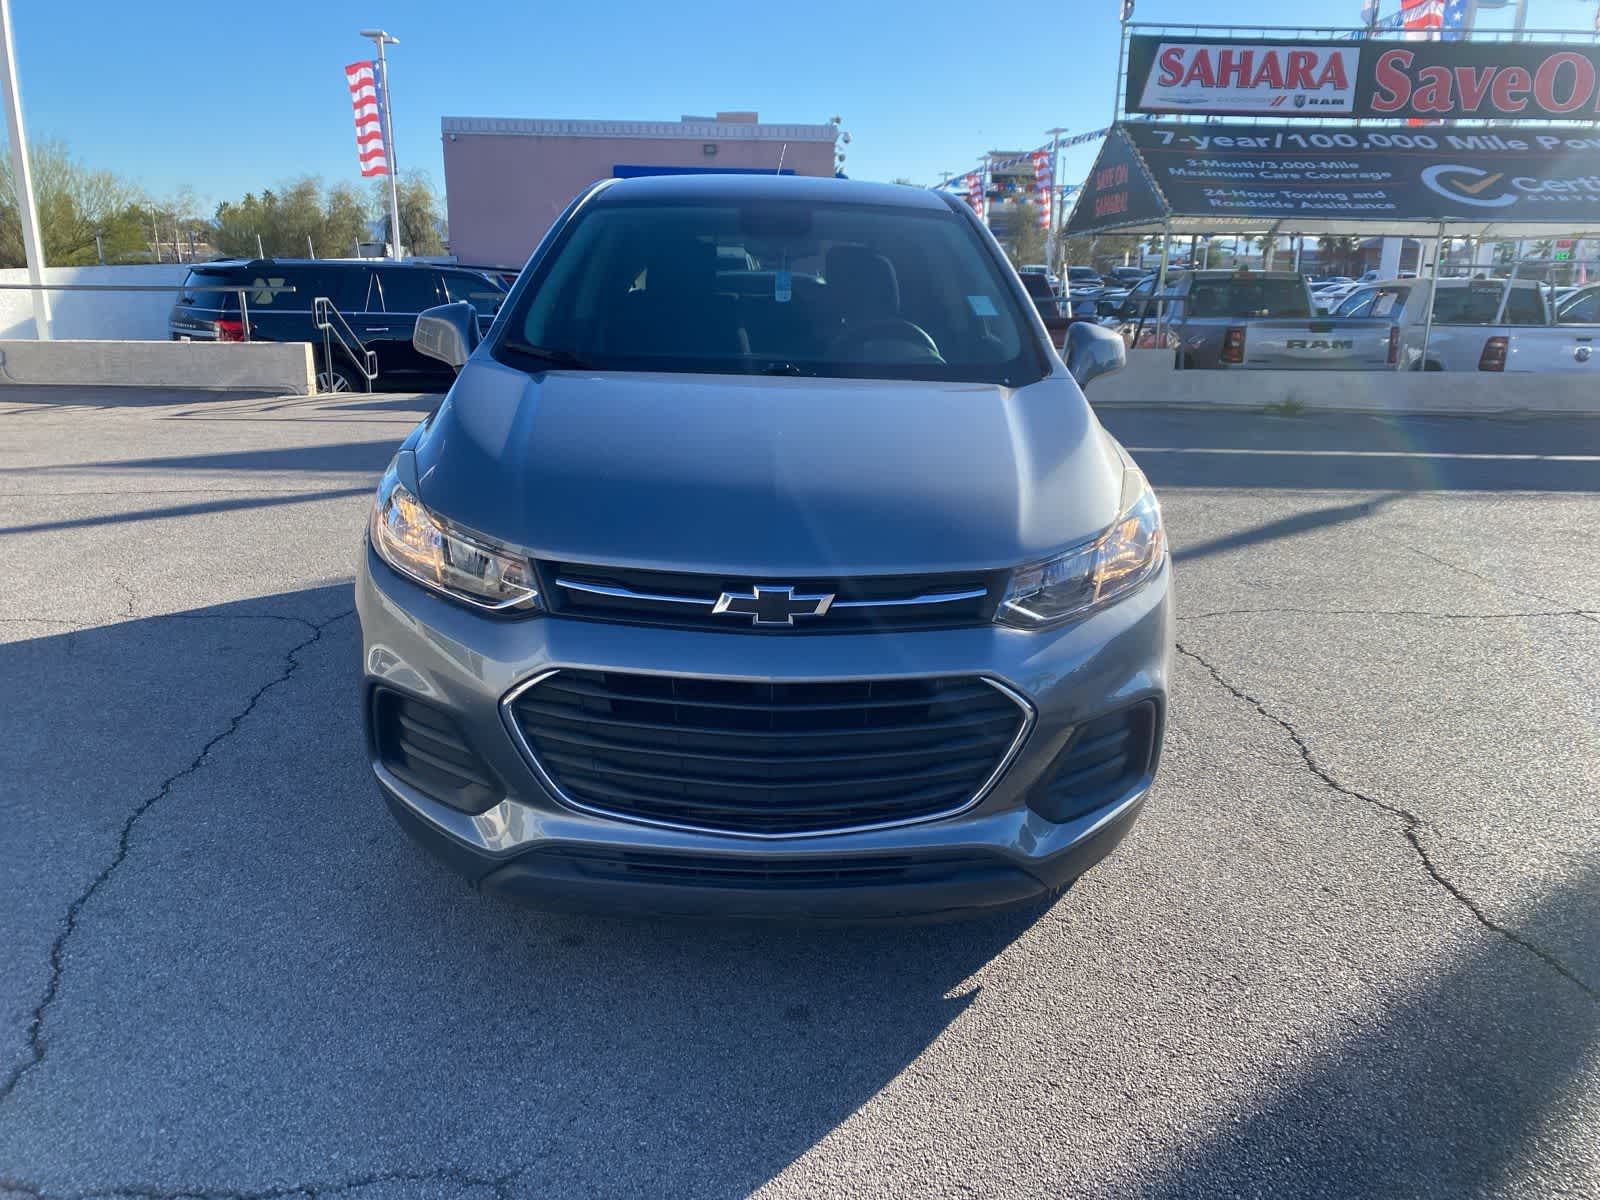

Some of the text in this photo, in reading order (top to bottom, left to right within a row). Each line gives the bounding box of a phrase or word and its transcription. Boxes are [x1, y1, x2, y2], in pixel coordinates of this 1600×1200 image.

[1157, 47, 1349, 90] SAHARA
[1370, 48, 1600, 113] SaveO
[1152, 130, 1438, 150] 7-year/100,000
[1445, 134, 1529, 150] Mile
[1185, 158, 1360, 170] 3-Month/3,000-Mile
[1168, 167, 1393, 181] Maximum Care Coverage
[1202, 187, 1387, 201] 24-Hour Towing and
[1208, 198, 1398, 209] Roadside Assistance
[1286, 339, 1353, 350] RAM
